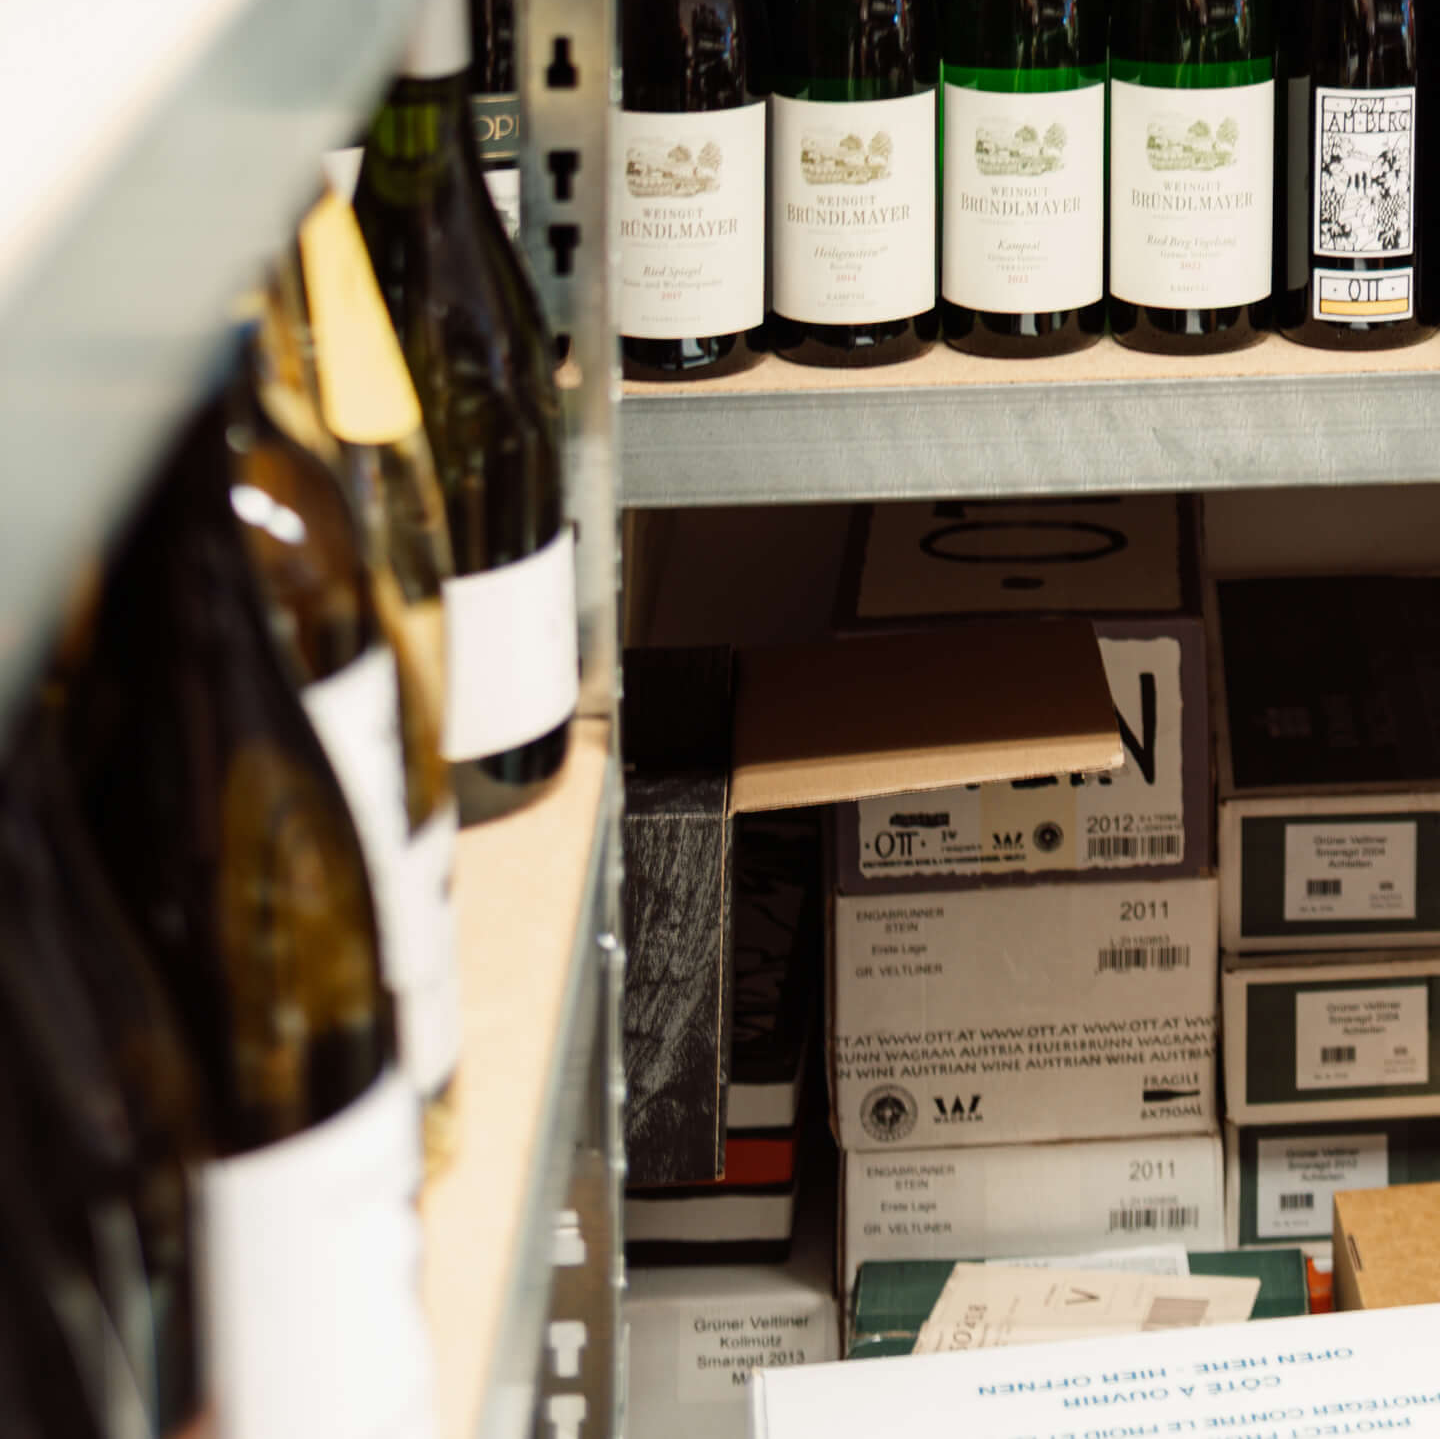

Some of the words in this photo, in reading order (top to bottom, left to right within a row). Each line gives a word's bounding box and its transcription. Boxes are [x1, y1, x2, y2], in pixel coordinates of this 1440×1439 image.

[1366, 110, 1408, 133] BERG
[991, 186, 1048, 197] WEINGUT
[1163, 181, 1221, 193] WEINGUT
[816, 194, 876, 207] WEINGUT
[961, 192, 1081, 216] BRÜNDLMAYER
[1131, 188, 1253, 212] BRÜNDLMAYER
[642, 207, 704, 220] WEINGUT
[787, 203, 911, 227] BRÜNDLMAYER
[1348, 278, 1383, 302] OTT
[1086, 814, 1135, 834] 2012
[875, 830, 920, 858] OTT
[855, 906, 944, 922] ENGABRUNNER
[1119, 900, 1169, 921] 2011
[885, 921, 919, 933] STEIN
[879, 962, 943, 977] VELTLINER
[877, 1029, 975, 1046] WWW.OTT.AT
[979, 1024, 1078, 1040] WWW.OTT.AT
[1082, 1016, 1179, 1034] WWW.OTT.AT
[884, 1047, 957, 1063] WAGRAM
[959, 1041, 1025, 1058] AUSTRIA
[1027, 1035, 1133, 1054] FEUERSBRUNN
[1136, 1032, 1208, 1049] WAGRAM
[856, 1066, 896, 1081] WINE
[900, 1061, 978, 1078] AUSTRIAN
[980, 1059, 1022, 1073] WINE
[1025, 1055, 1101, 1071] AUSTRIAN
[1104, 1051, 1146, 1066] WINE
[1143, 1073, 1200, 1087] FRAGILE
[865, 1164, 956, 1178] ENGABRUNNER
[1128, 1160, 1178, 1181] 2011
[894, 1178, 929, 1191] STEIN
[888, 1222, 953, 1236] VELTLINER
[694, 1315, 744, 1332] Grüner
[748, 1313, 809, 1331] Veltliner
[720, 1333, 783, 1349] Kollmütz
[697, 1351, 764, 1371] Smaragd
[767, 1350, 806, 1366] 2013
[1194, 1355, 1268, 1374] HERE
[1278, 1346, 1354, 1365] OPEN
[1102, 1367, 1167, 1384] HIER
[1062, 1387, 1171, 1408] OUVRIR
[1168, 1418, 1196, 1432] LE
[1206, 1405, 1306, 1428] CONTRE
